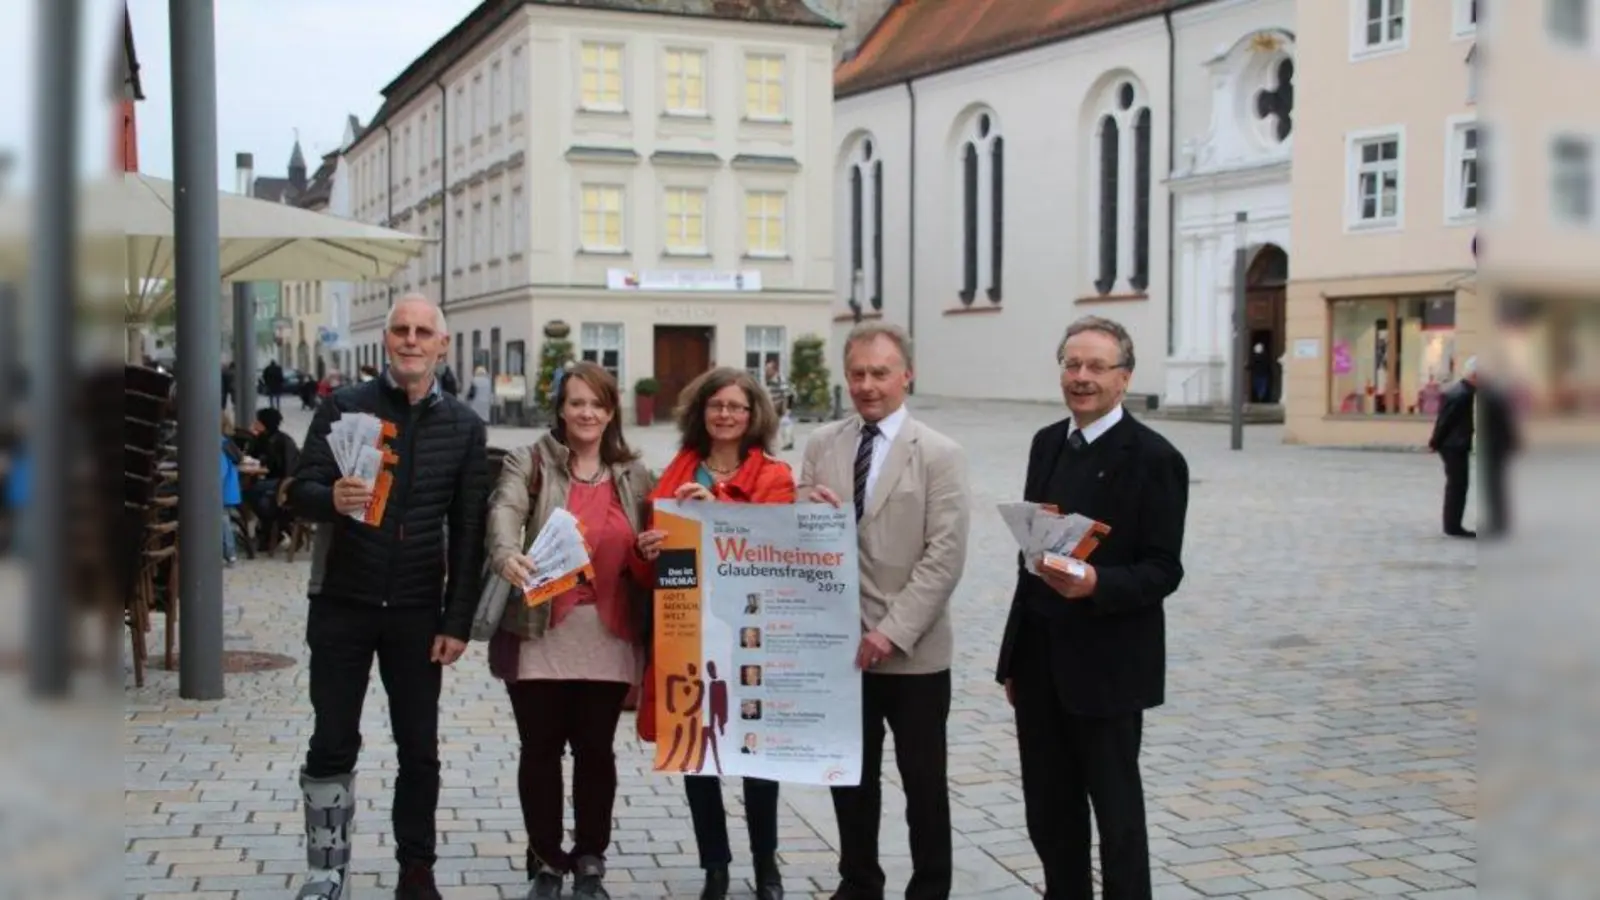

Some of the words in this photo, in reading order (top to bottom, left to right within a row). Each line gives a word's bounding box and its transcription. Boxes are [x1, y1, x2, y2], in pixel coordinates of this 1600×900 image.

[714, 536, 844, 566] Weilheimer
[717, 563, 833, 582] Glaubensfragen
[818, 582, 845, 594] 2017
